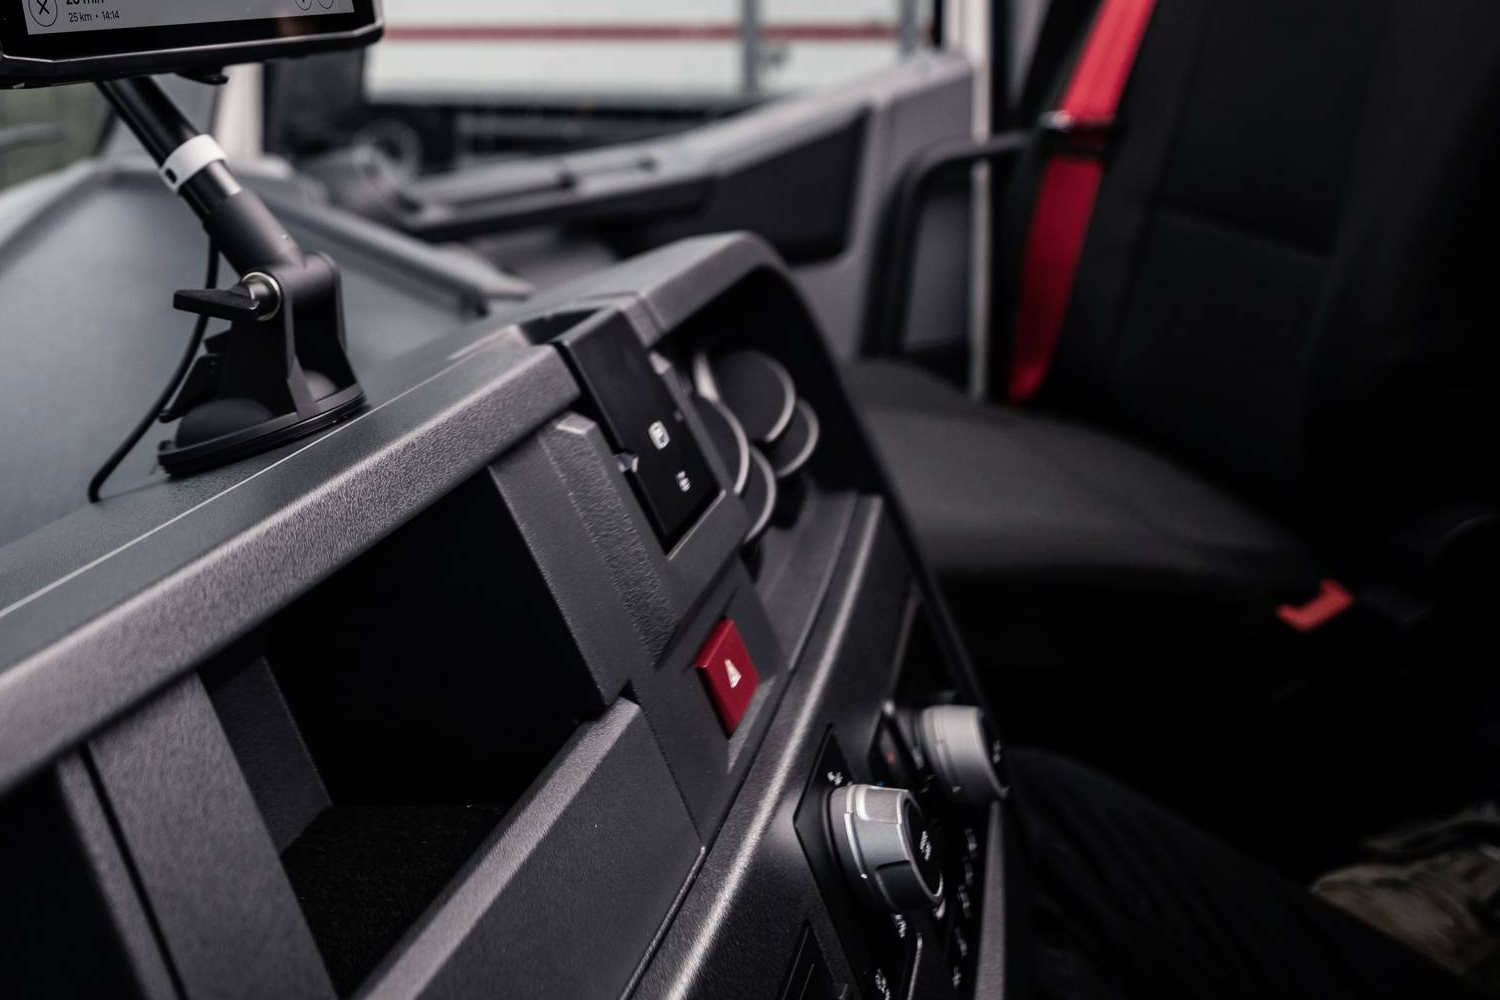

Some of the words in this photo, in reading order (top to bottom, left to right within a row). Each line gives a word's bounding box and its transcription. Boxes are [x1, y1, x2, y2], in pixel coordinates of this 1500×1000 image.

[68, 12, 79, 22] 25
[79, 11, 92, 21] km
[101, 10, 120, 21] 14:14
